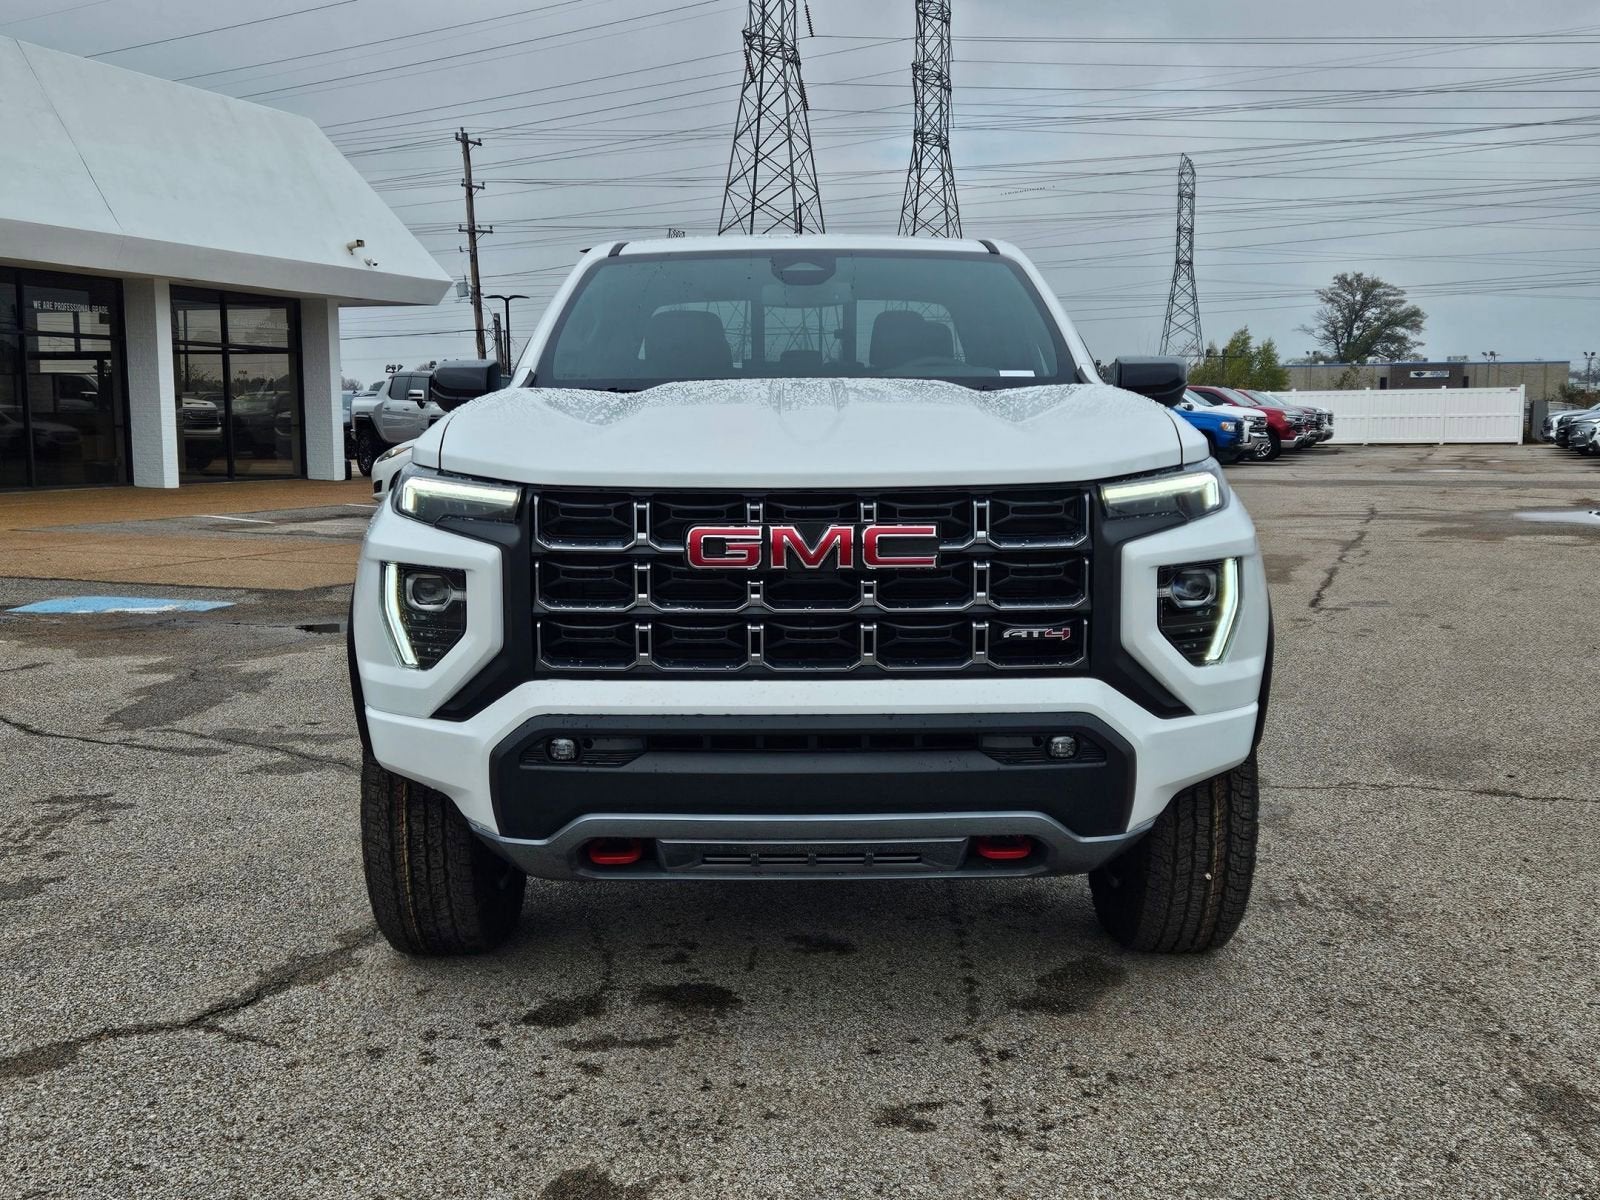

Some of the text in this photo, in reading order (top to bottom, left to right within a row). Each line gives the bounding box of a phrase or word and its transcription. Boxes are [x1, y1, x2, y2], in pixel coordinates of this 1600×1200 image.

[33, 300, 109, 314] WE ARE PROFESSIONAL GRADE
[687, 525, 937, 569] GMC
[1002, 627, 1071, 640] AT4
